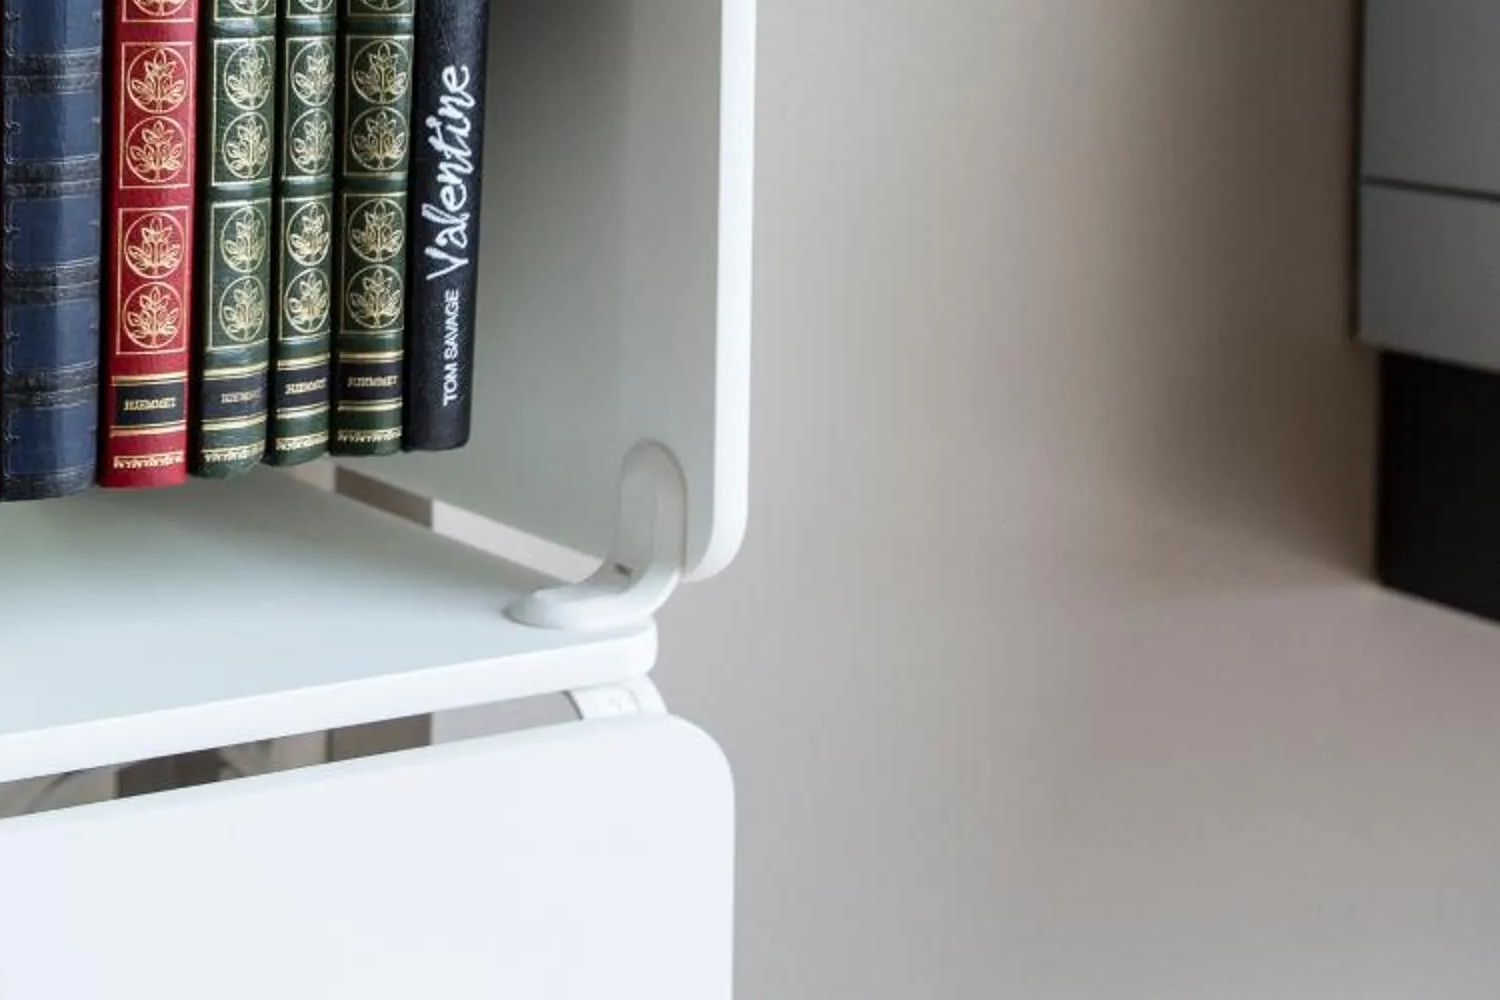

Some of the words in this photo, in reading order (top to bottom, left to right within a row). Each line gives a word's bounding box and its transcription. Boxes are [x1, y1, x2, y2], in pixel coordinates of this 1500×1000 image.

[421, 63, 476, 281] Valentine
[444, 288, 460, 360] SAVAGE
[442, 363, 459, 407] TOM
